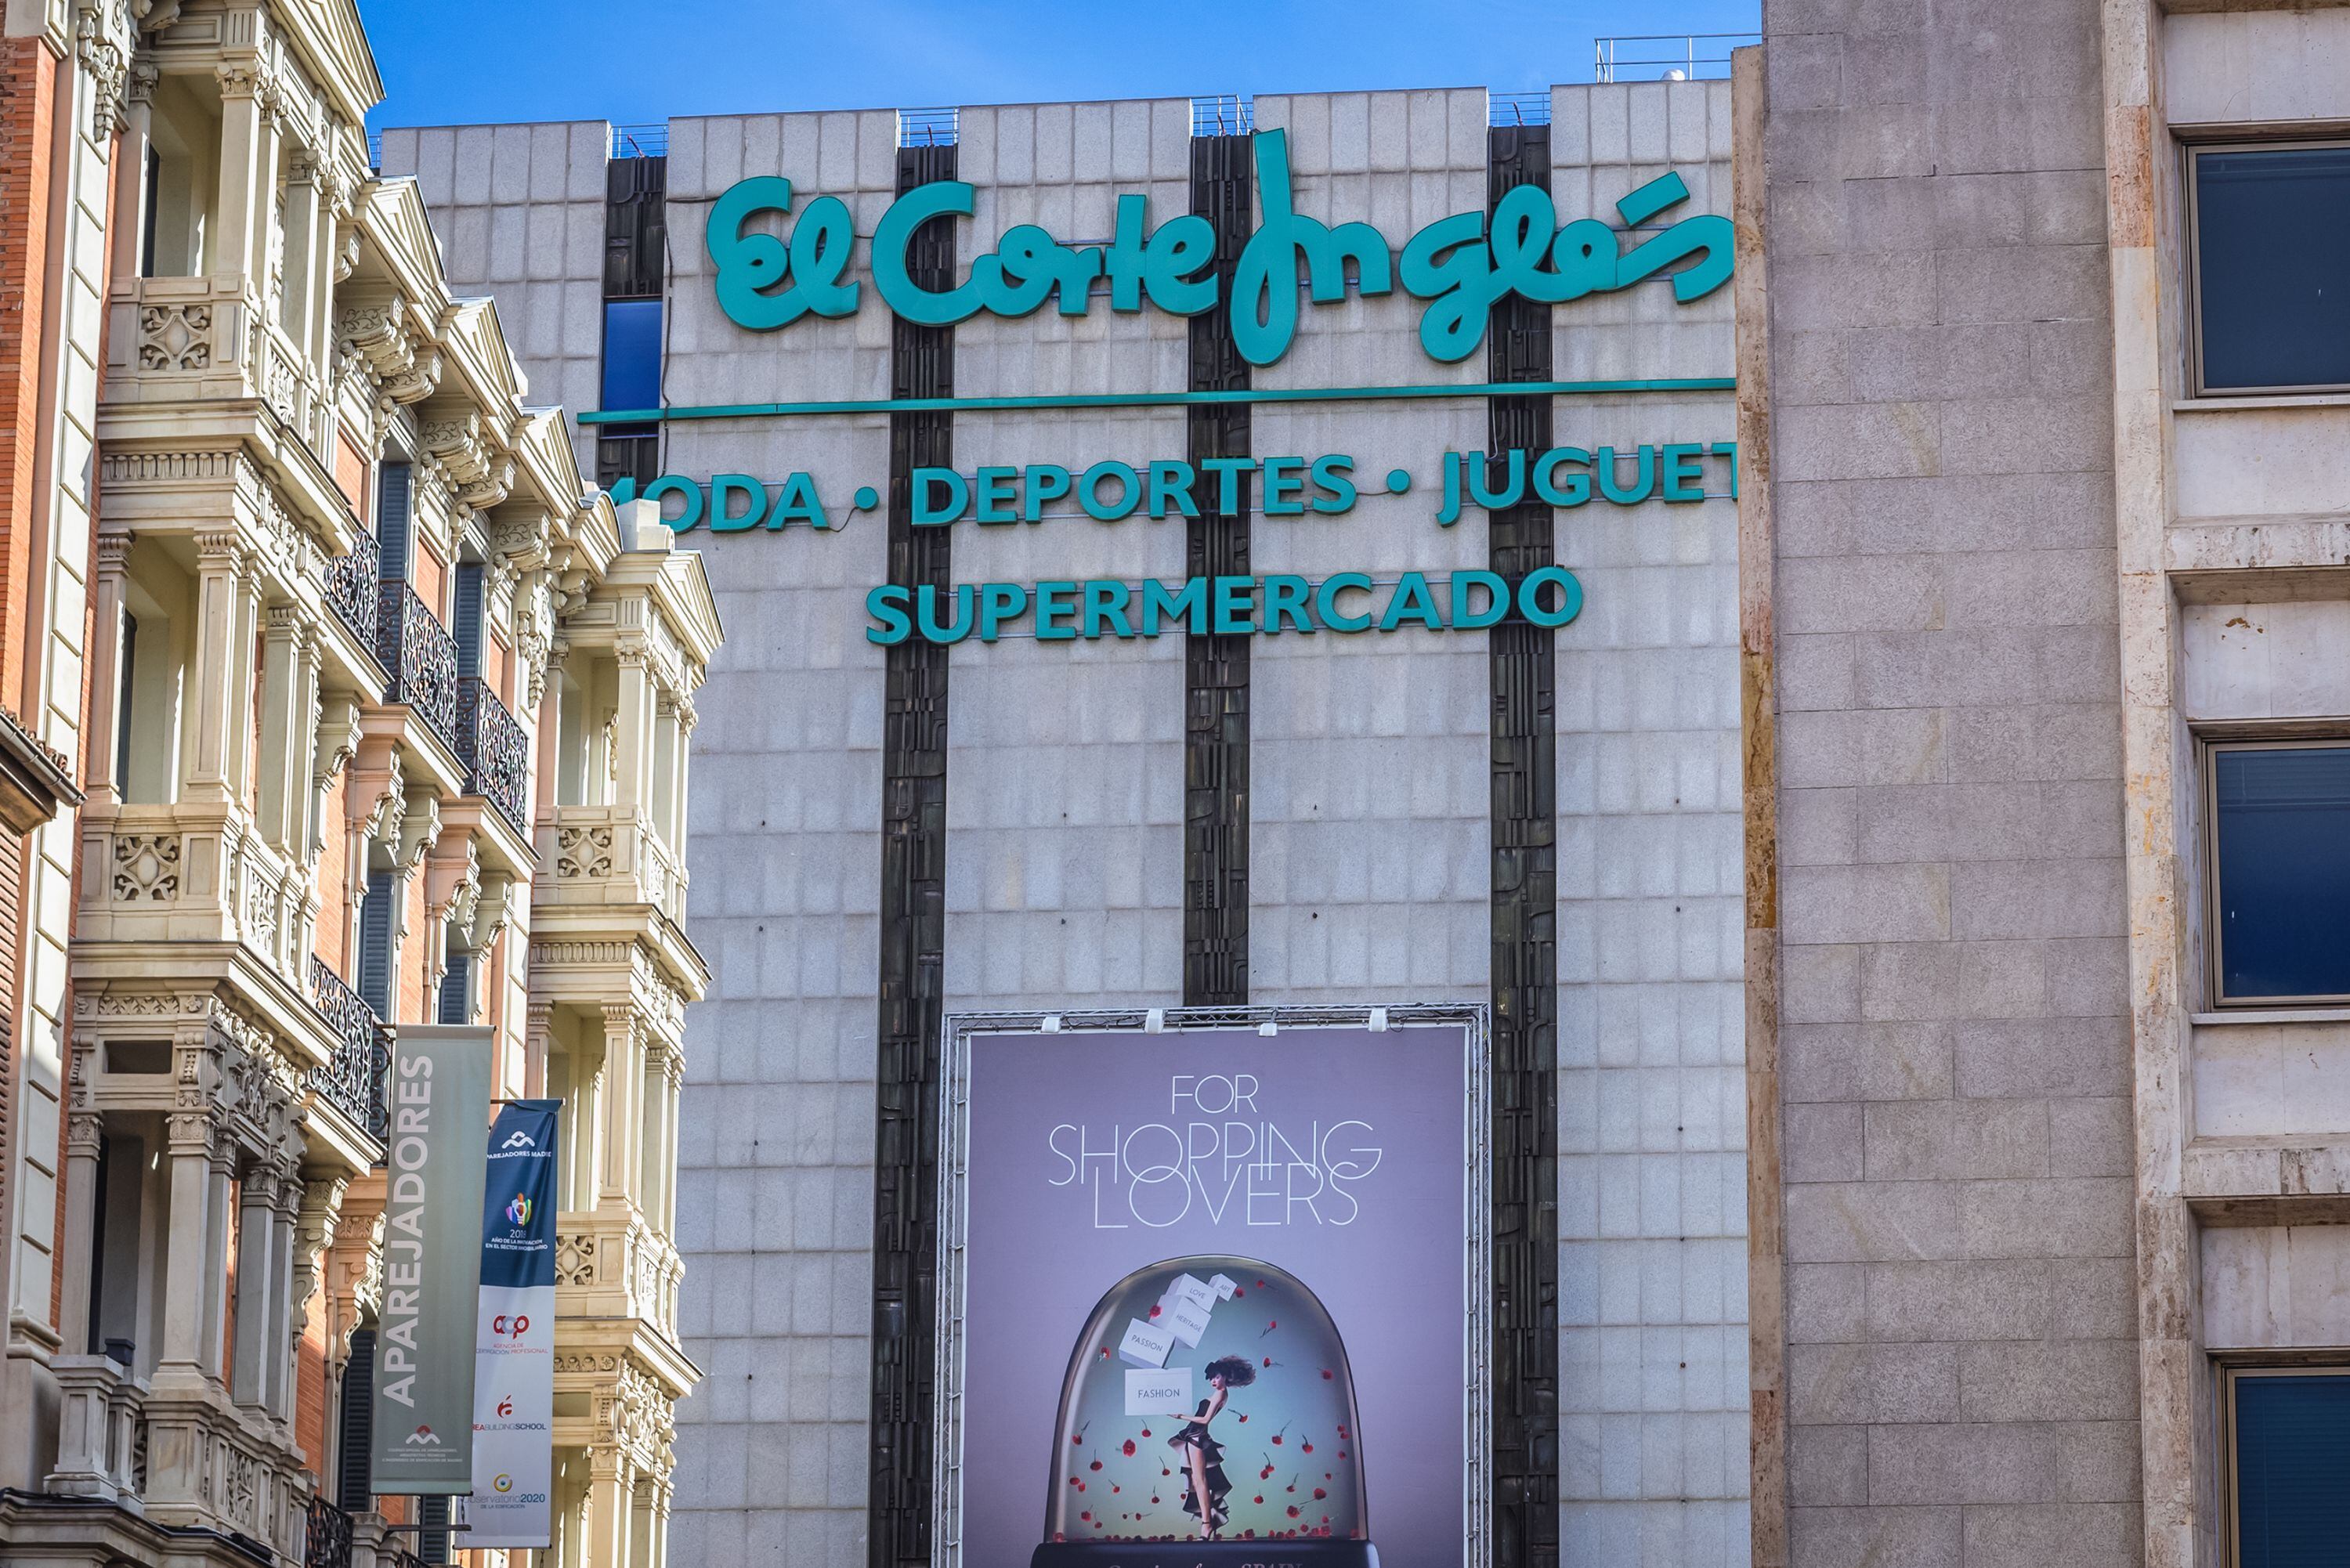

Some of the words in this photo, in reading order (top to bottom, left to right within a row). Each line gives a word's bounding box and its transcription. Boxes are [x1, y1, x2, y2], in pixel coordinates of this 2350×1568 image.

[706, 175, 860, 332] El
[872, 180, 1219, 327] Corte
[1230, 128, 1734, 367] Inglés
[910, 454, 1357, 527] DEPORTES
[866, 565, 1583, 645] SUPERMERCADO
[1171, 1074, 1259, 1115] FOR
[1048, 1120, 1383, 1186] SHOPPING
[1094, 1161, 1359, 1229] LOVERS
[382, 1054, 433, 1408] APAREJADORES
[1188, 1287, 1206, 1300] LOVE
[1219, 1284, 1231, 1292] ART
[1130, 1334, 1164, 1353] PASSION
[1176, 1313, 1202, 1332] HERITAGE
[1137, 1389, 1180, 1399] FASHION
